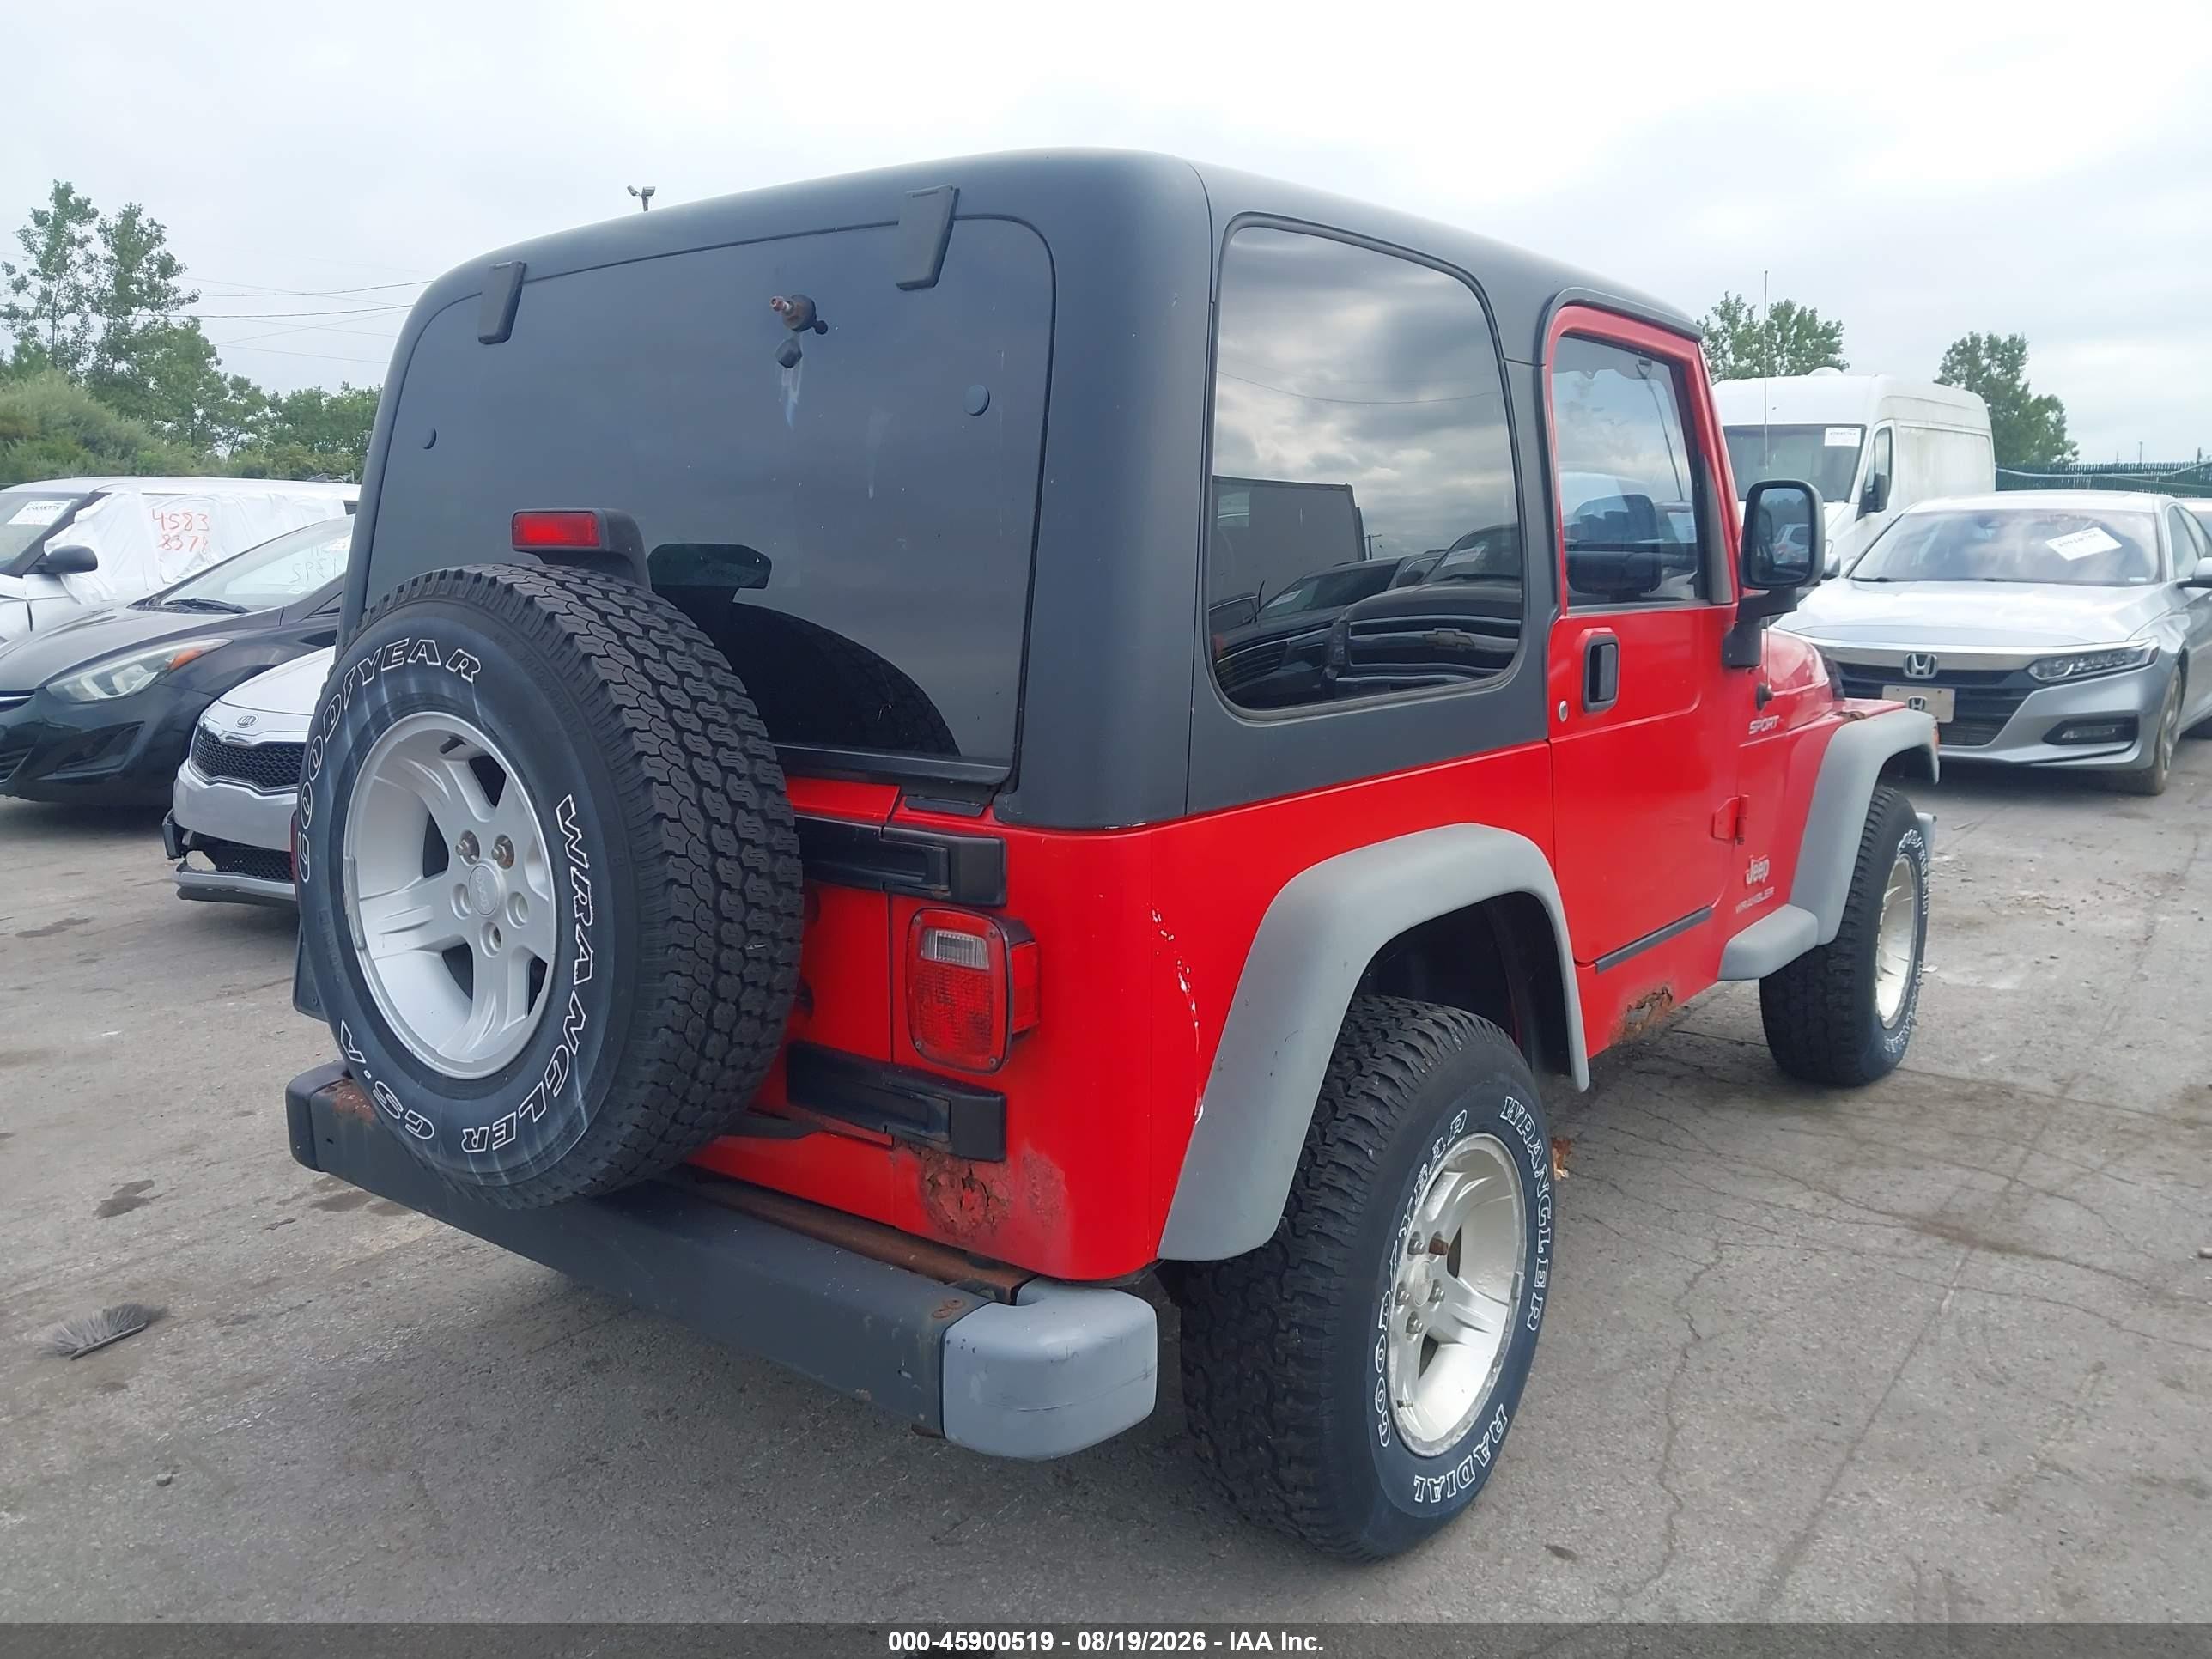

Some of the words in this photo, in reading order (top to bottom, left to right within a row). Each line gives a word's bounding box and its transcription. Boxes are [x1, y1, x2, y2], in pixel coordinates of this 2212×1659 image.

[152, 508, 210, 531] 4583
[236, 714, 258, 727] KIA
[297, 637, 482, 883] GOODYEAR
[1748, 714, 1780, 735] SPORT
[1744, 854, 1771, 885] Jeep
[460, 793, 594, 1154] WRANGLER
[1500, 1095, 1553, 1332] WRANGLER
[1374, 1109, 1468, 1448] GOODYEAR
[1413, 1404, 1509, 1504] RADIAL
